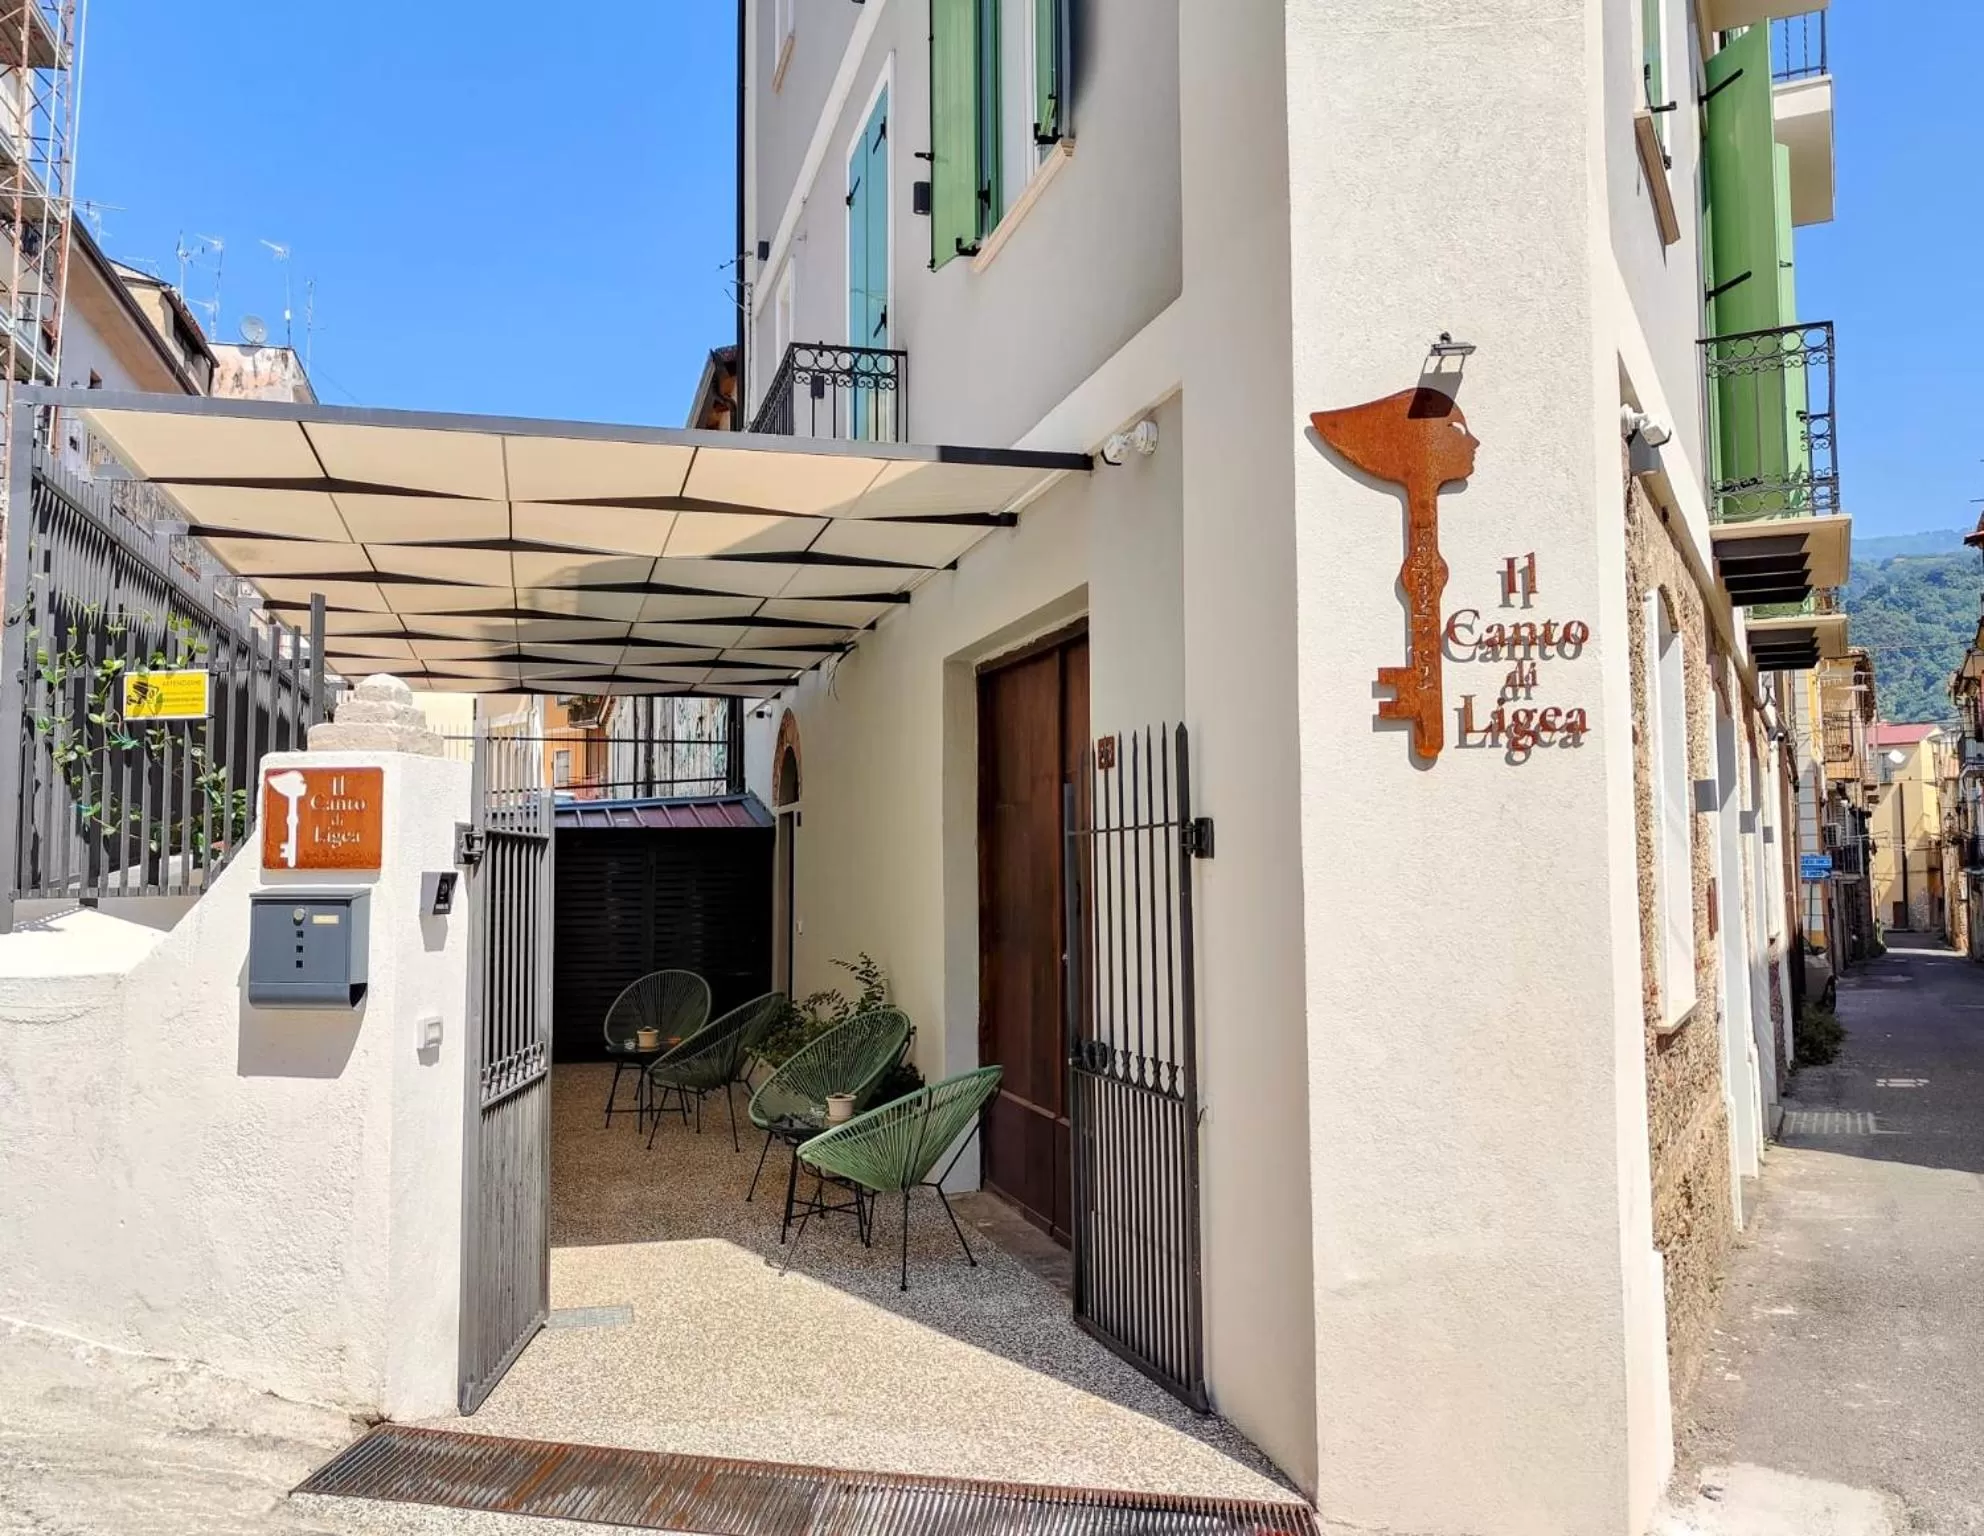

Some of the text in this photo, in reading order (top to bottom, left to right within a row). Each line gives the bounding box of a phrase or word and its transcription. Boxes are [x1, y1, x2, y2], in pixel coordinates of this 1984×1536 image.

[1502, 552, 1539, 594] Il
[1446, 609, 1590, 648] Canto
[1505, 659, 1539, 688] di
[1459, 694, 1592, 752] Ligea
[332, 775, 345, 796] Il
[310, 793, 366, 811] Canto
[314, 825, 360, 849] Ligea
